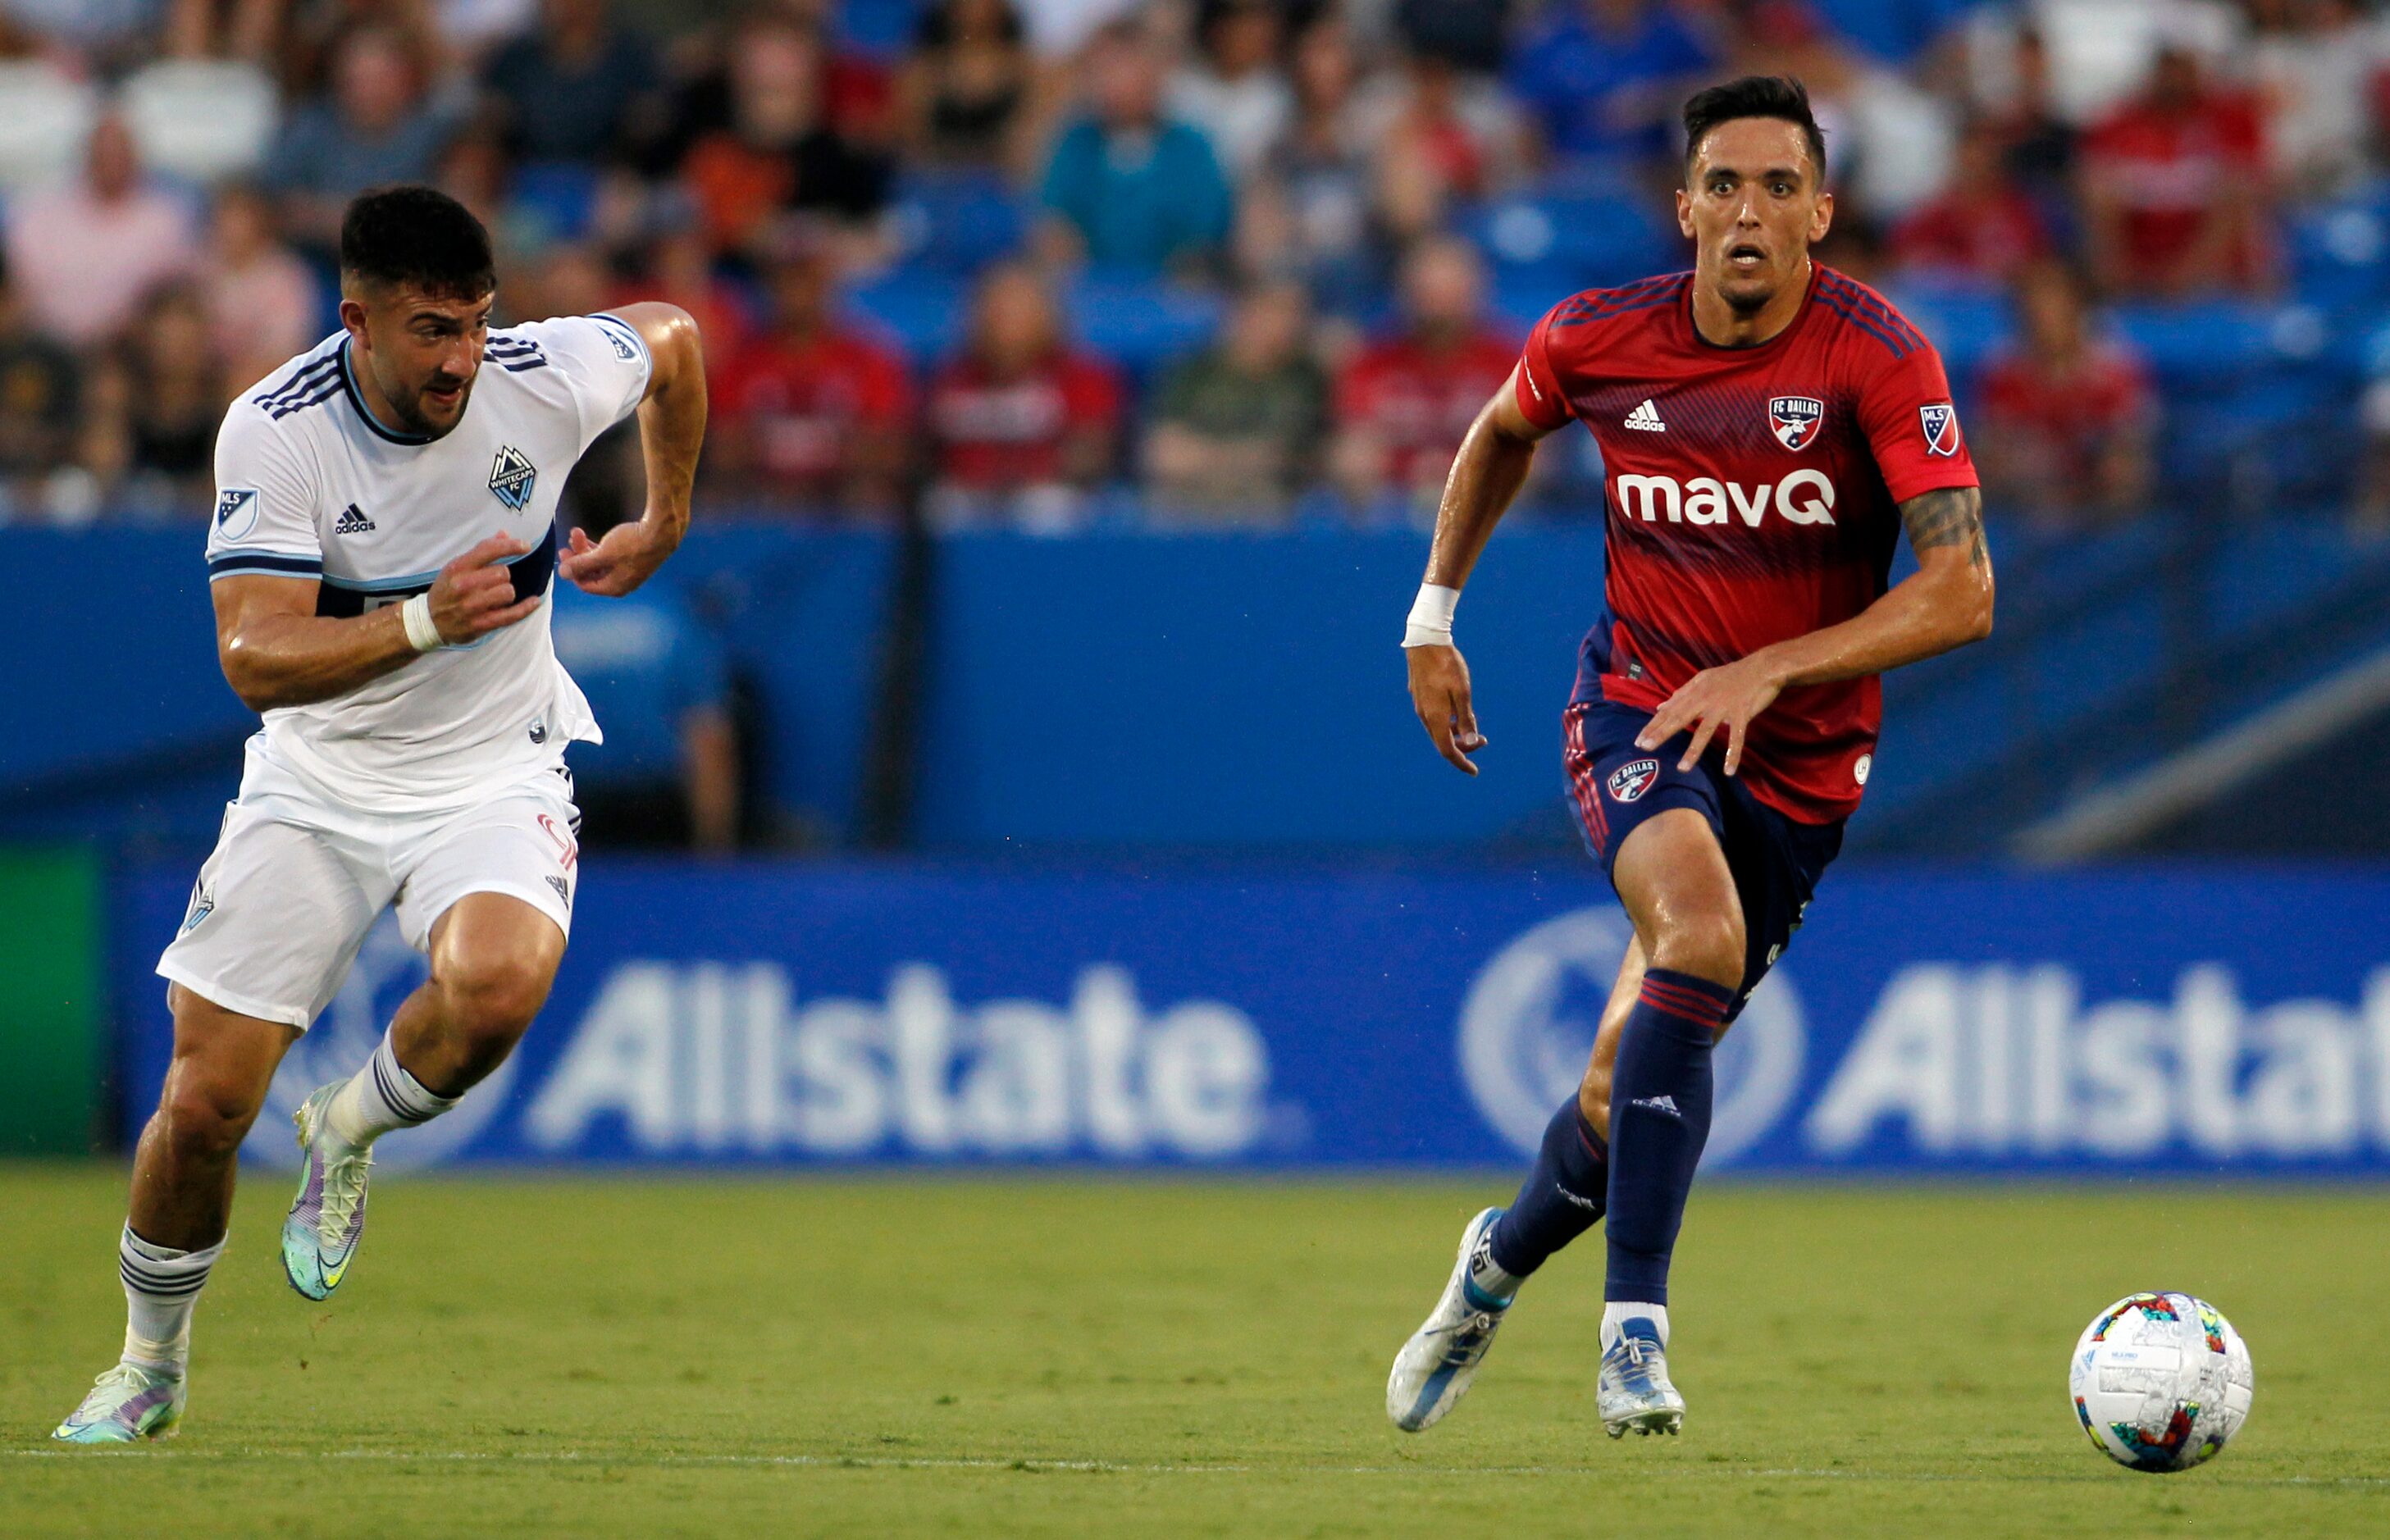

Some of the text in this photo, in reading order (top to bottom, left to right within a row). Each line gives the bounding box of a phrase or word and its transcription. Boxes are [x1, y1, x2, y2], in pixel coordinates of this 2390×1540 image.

[1773, 400, 1819, 415] FC DALLAS
[1924, 409, 1944, 421] MLS
[1625, 418, 1666, 432] adidas
[490, 469, 534, 489] WHITECAPS
[509, 482, 520, 491] FC
[221, 492, 240, 504] MLS
[1617, 468, 1836, 527] mavQ
[335, 520, 376, 534] adidas
[1611, 762, 1654, 787] FC DALLAS
[525, 961, 1267, 1150] Allstate
